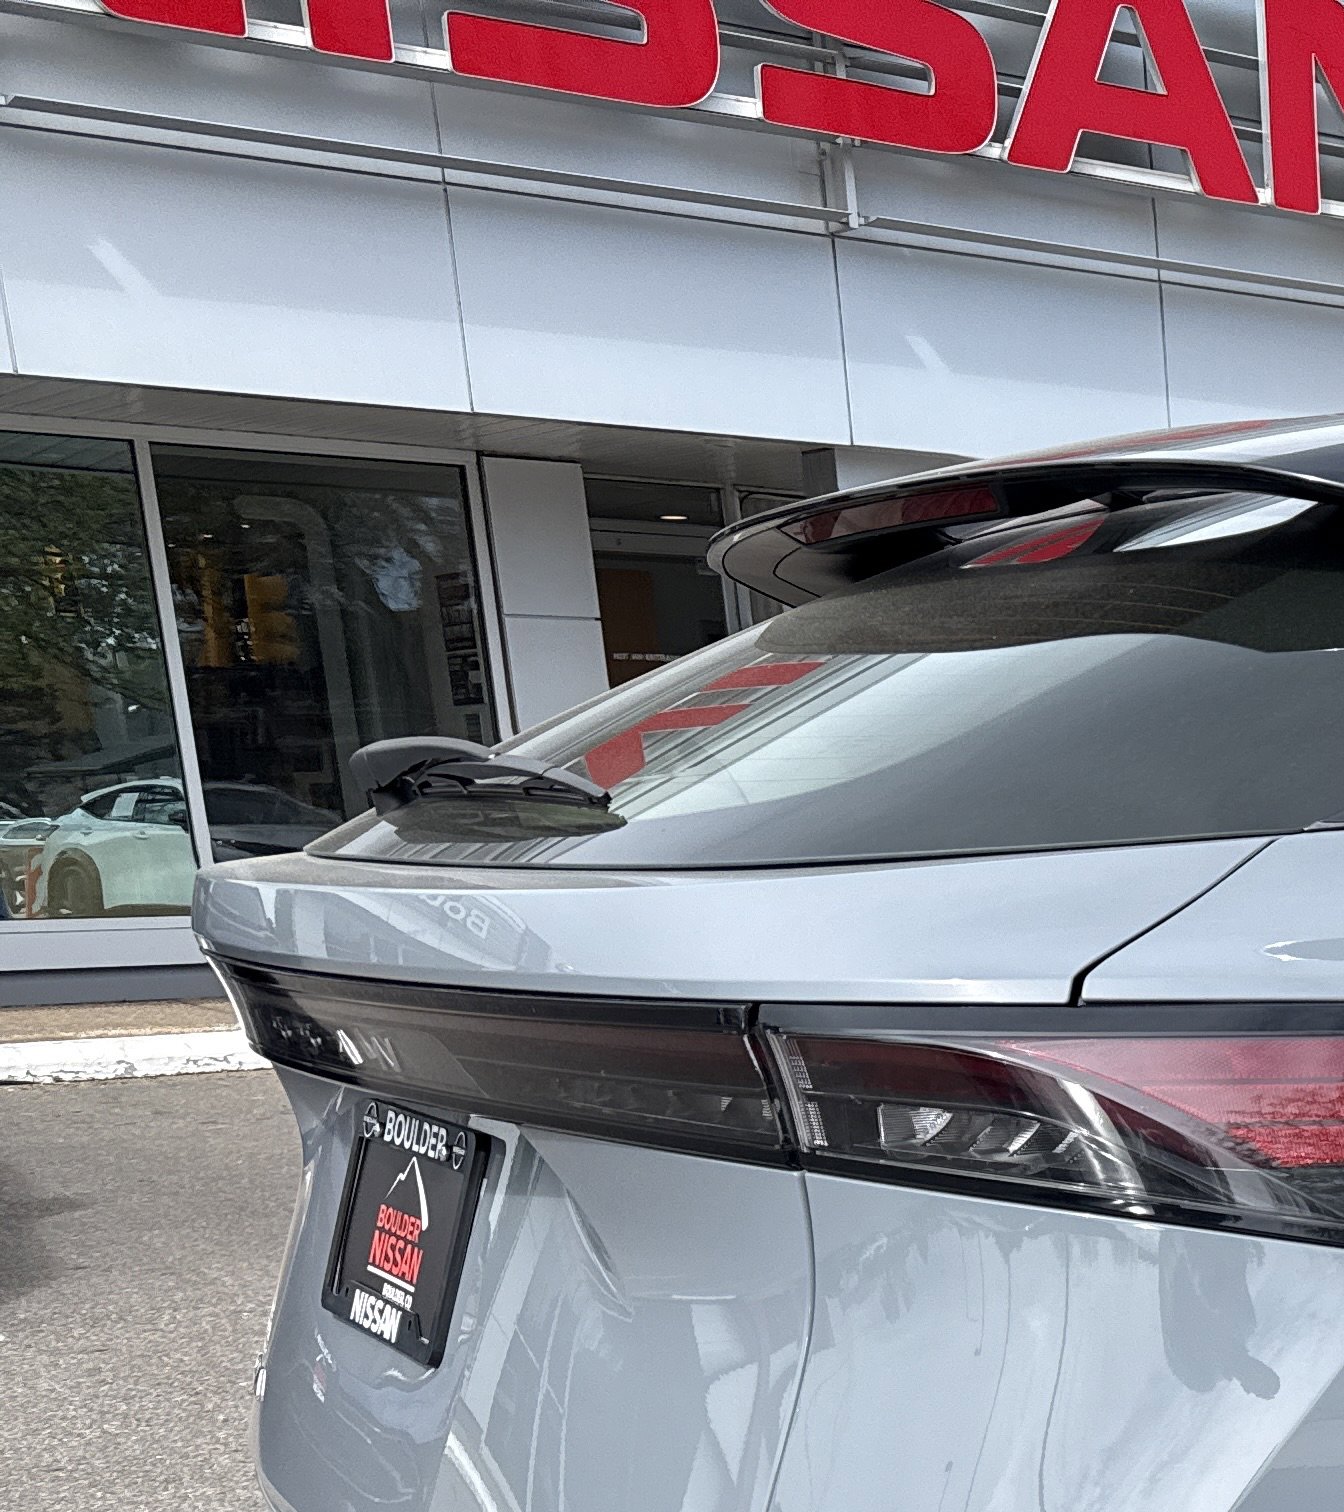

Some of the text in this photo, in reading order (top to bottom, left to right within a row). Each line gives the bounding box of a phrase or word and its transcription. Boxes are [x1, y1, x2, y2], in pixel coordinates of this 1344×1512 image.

[384, 1109, 448, 1160] BOULDER
[377, 1203, 422, 1244] BOULDER
[368, 1229, 424, 1285] NISSAN
[350, 1288, 403, 1344] NISSAN
